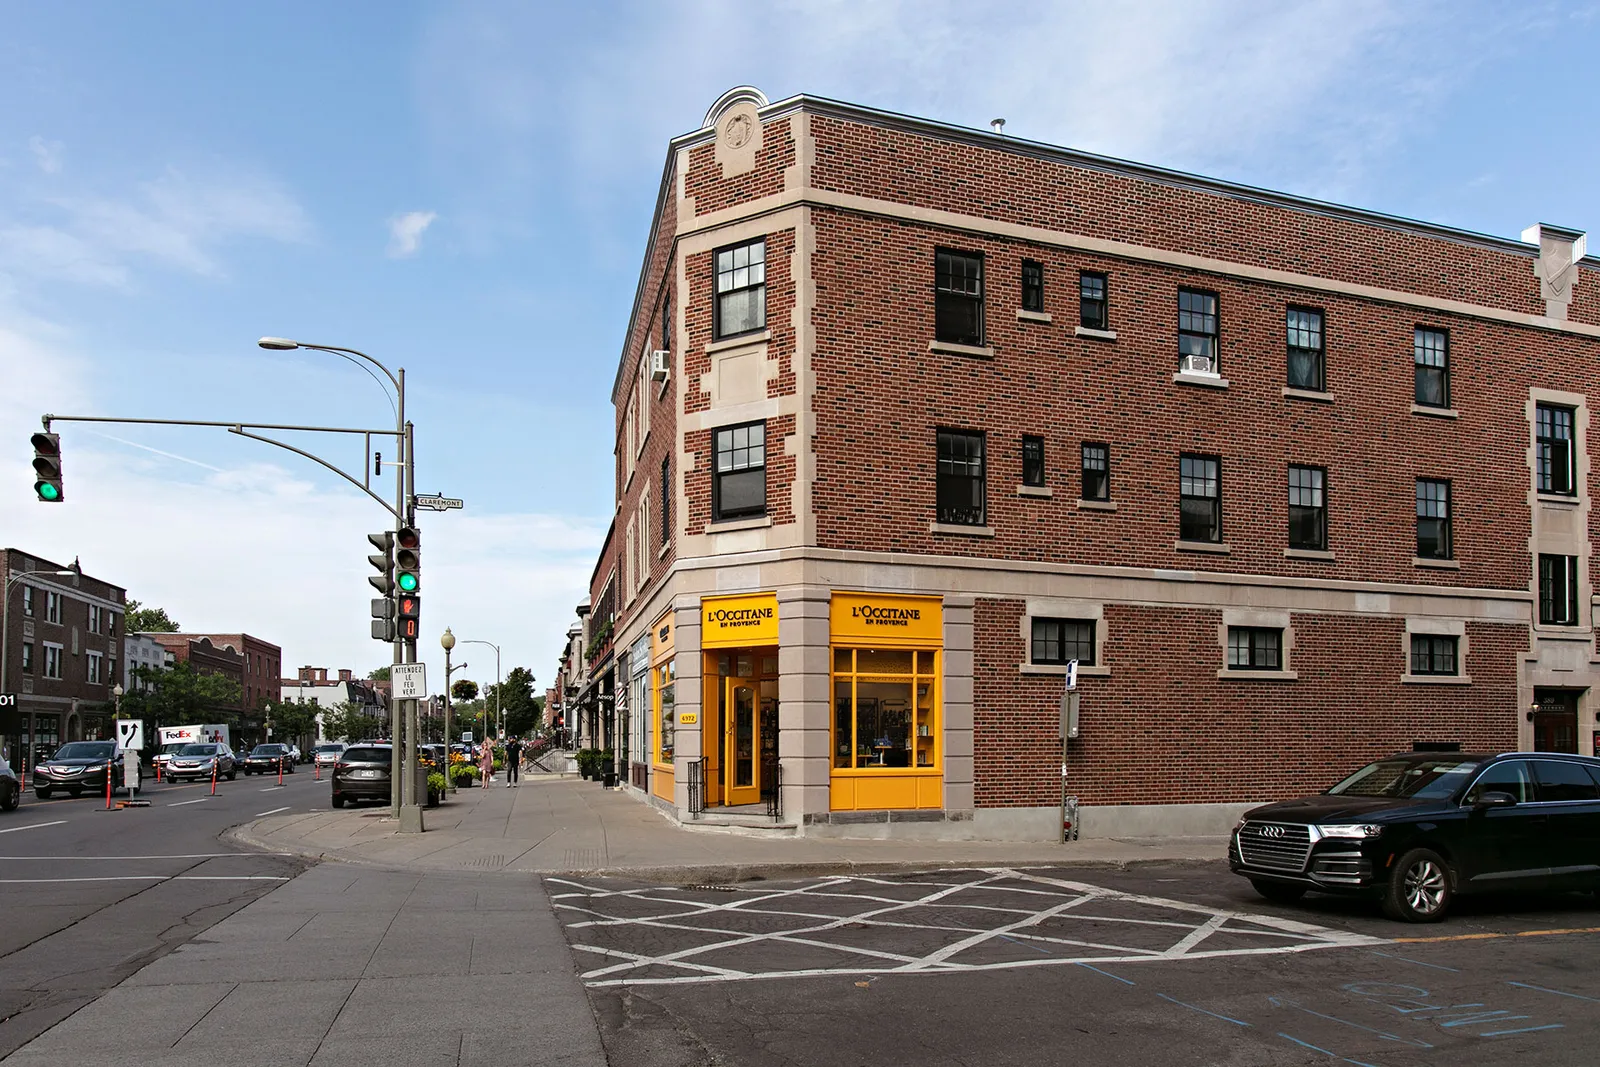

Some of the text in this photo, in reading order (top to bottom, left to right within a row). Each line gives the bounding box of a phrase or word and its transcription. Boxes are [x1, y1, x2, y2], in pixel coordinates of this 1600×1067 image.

[708, 608, 773, 622] L'OCCITANE
[853, 605, 920, 620] L'OCCITANE
[395, 666, 422, 674] ATTENDEZ
[166, 730, 191, 739] FedEx
